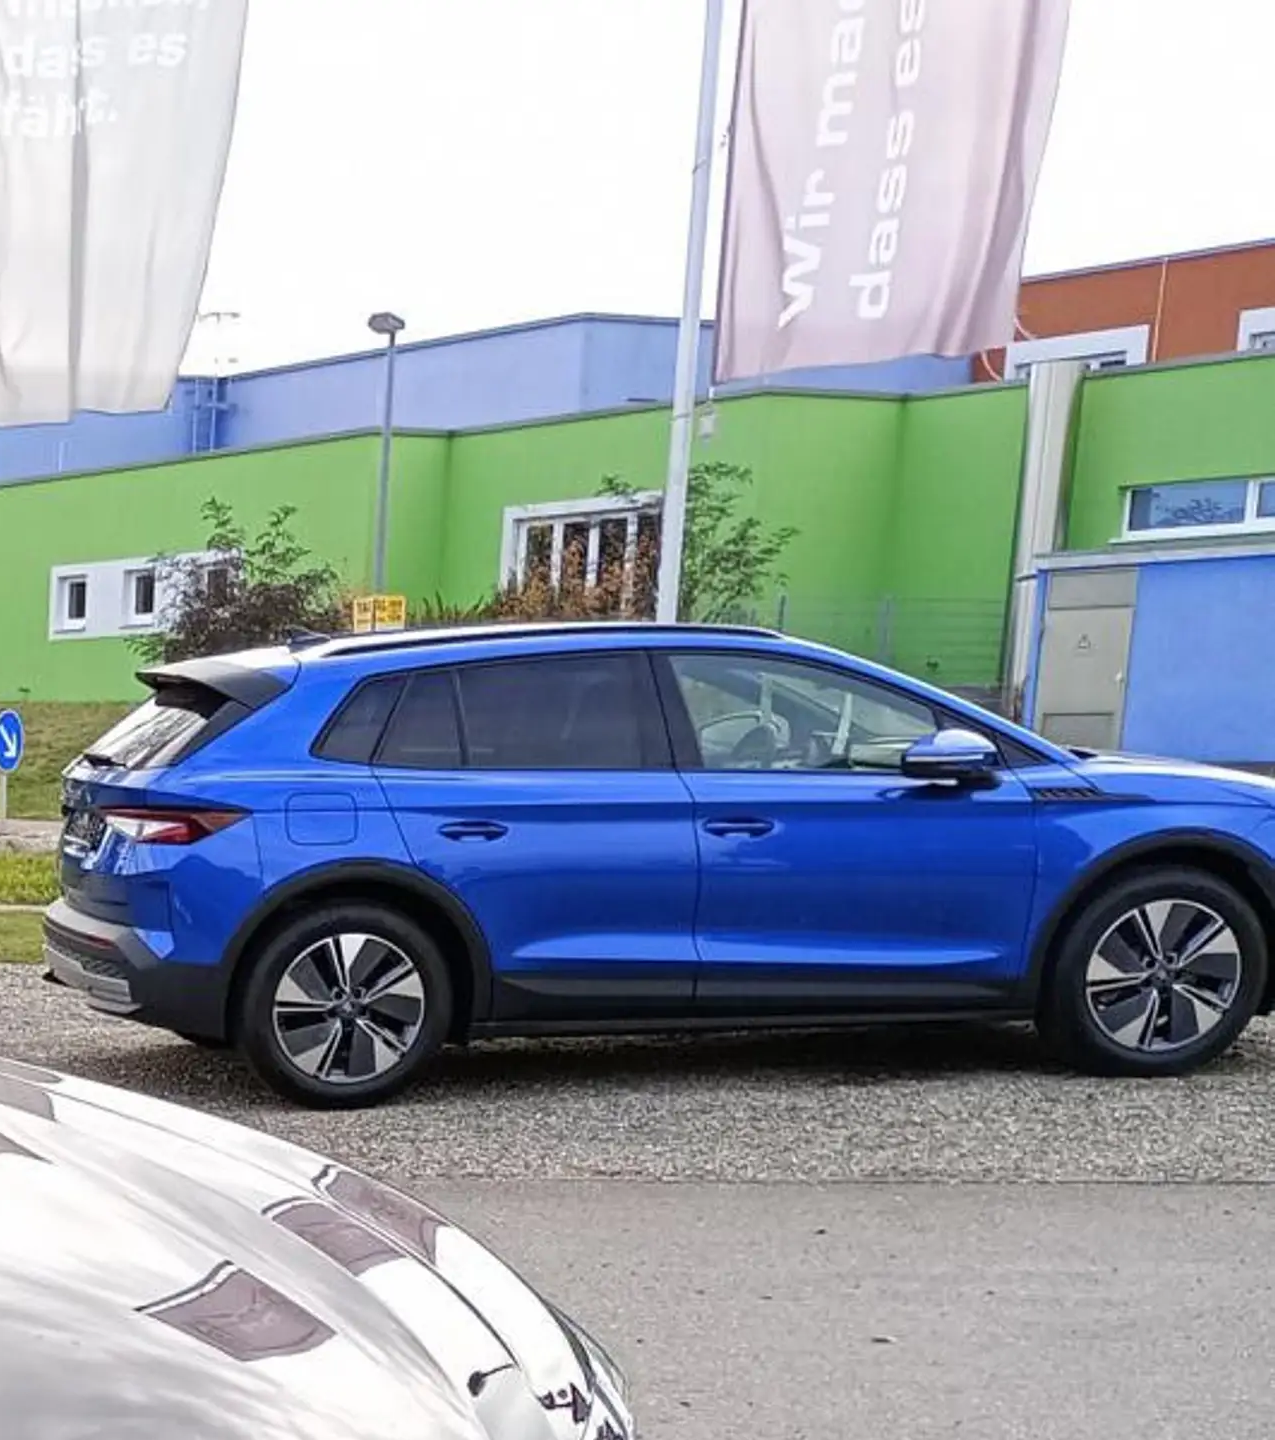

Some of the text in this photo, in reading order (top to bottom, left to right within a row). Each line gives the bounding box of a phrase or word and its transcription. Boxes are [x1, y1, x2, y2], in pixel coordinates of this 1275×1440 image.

[127, 32, 188, 67] es
[776, 168, 836, 331] Wir
[848, 109, 914, 319] dass
